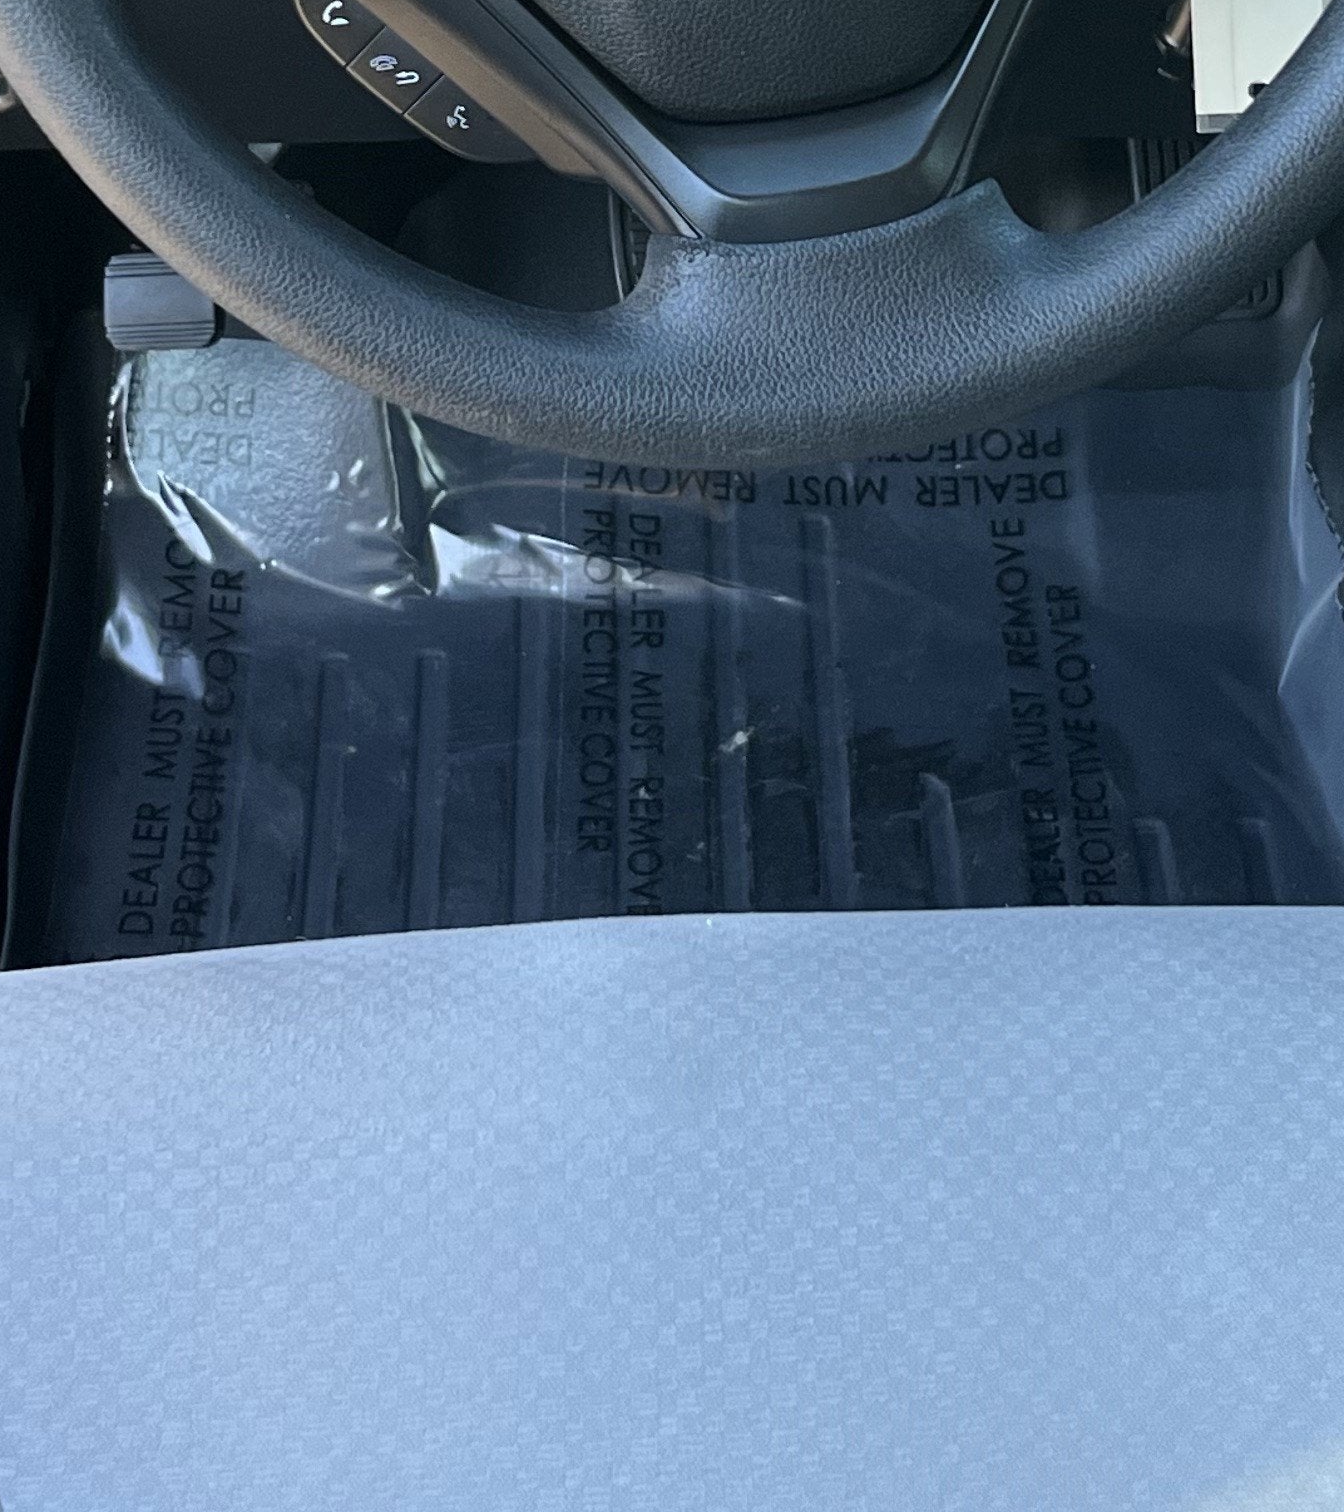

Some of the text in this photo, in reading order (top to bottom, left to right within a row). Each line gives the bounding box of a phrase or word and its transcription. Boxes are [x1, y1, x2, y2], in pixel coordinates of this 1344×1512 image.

[584, 459, 1071, 508] DEALER MUST REMOVE
[989, 518, 1044, 670] REMOVE
[143, 688, 186, 780] MUST
[169, 568, 249, 937] PROTECTIVE COVER
[629, 669, 665, 753] MUST
[1010, 688, 1056, 767] MUST
[1045, 584, 1118, 906] PROTECTIVE COVER
[577, 733, 617, 853] COVER
[118, 802, 172, 935] DEALER
